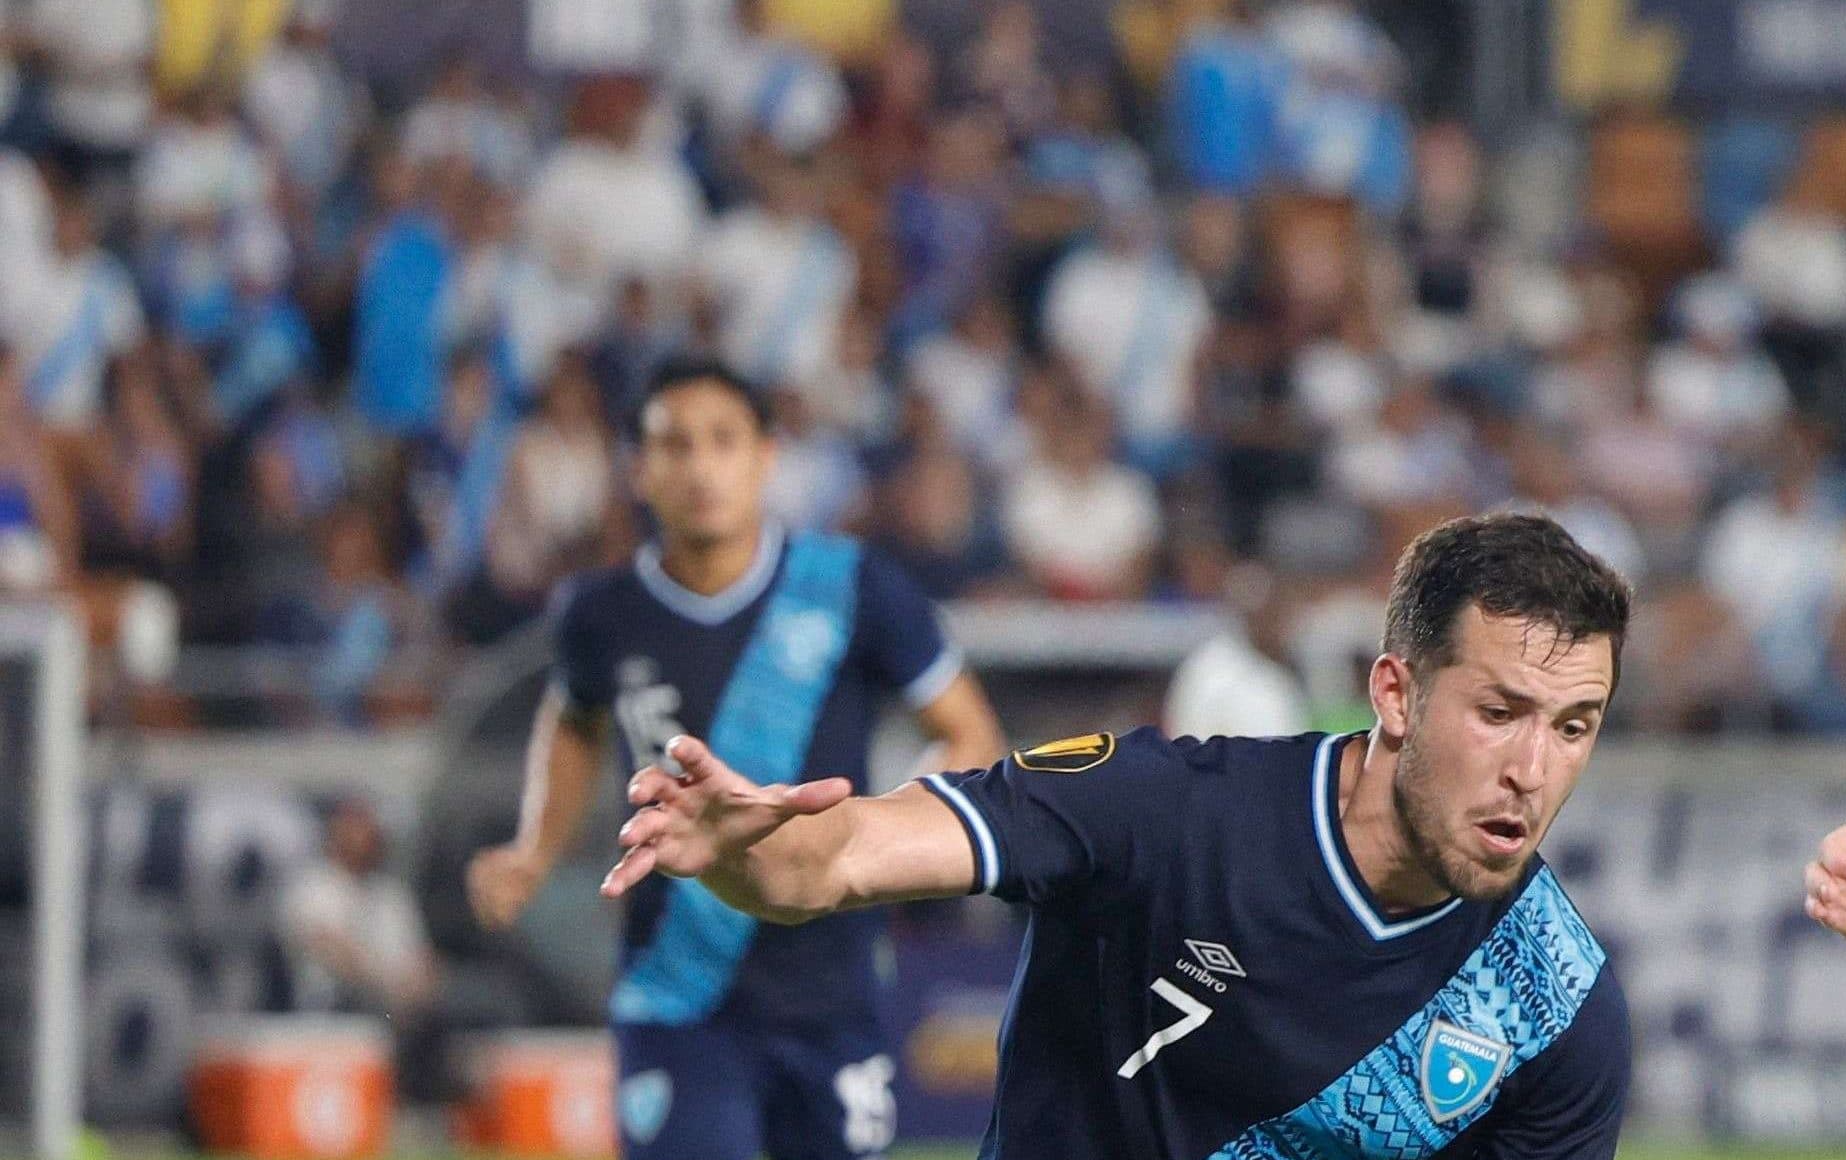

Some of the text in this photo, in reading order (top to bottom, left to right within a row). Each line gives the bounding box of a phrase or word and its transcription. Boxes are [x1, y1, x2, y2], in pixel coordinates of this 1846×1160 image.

[1175, 957, 1227, 993] umbro
[1117, 976, 1214, 1079] 7
[1439, 1033, 1497, 1062] GUATEMALA
